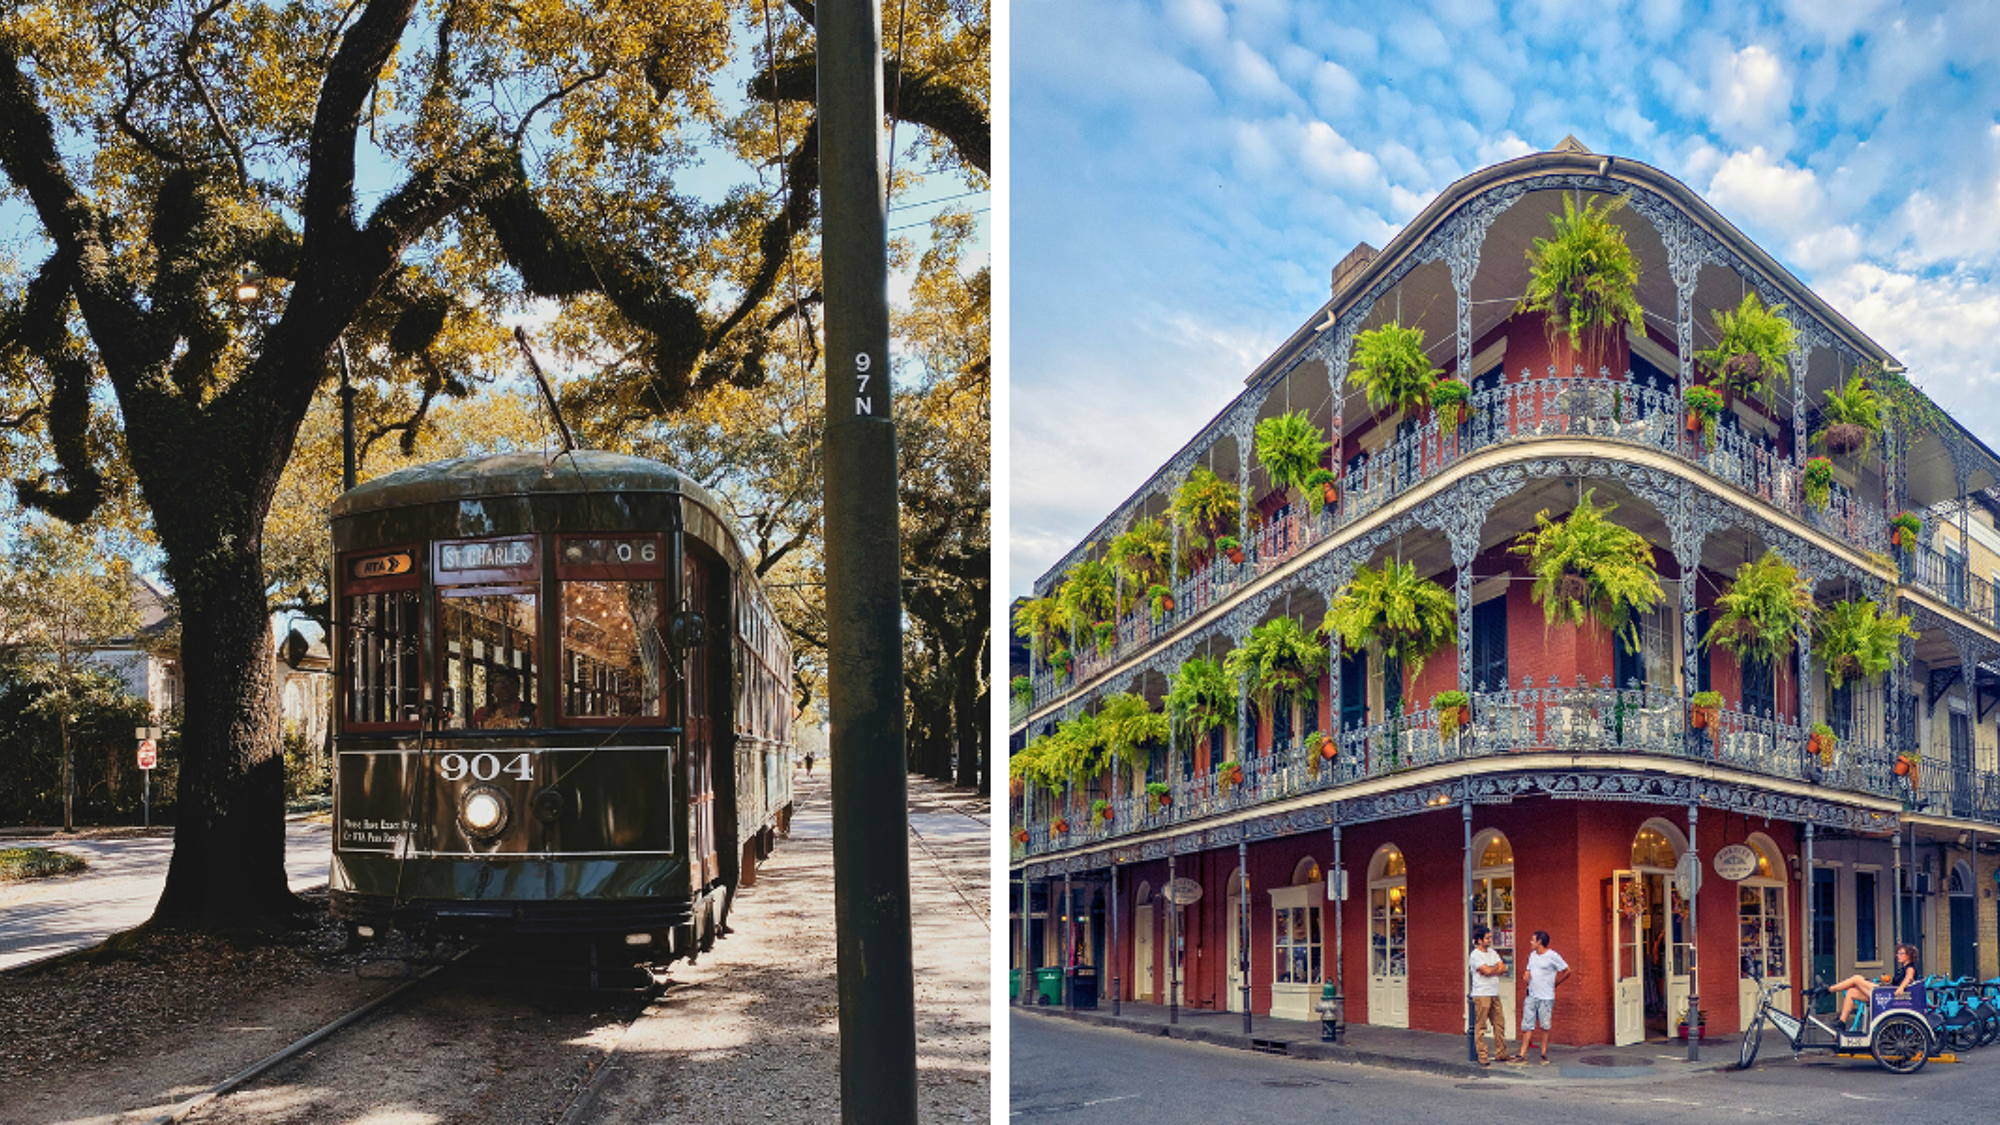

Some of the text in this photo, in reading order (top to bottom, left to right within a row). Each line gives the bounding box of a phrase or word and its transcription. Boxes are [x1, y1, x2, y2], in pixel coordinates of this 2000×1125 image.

[467, 545, 529, 566] CHARLES
[364, 560, 386, 574] RTA
[440, 753, 534, 781] 904
